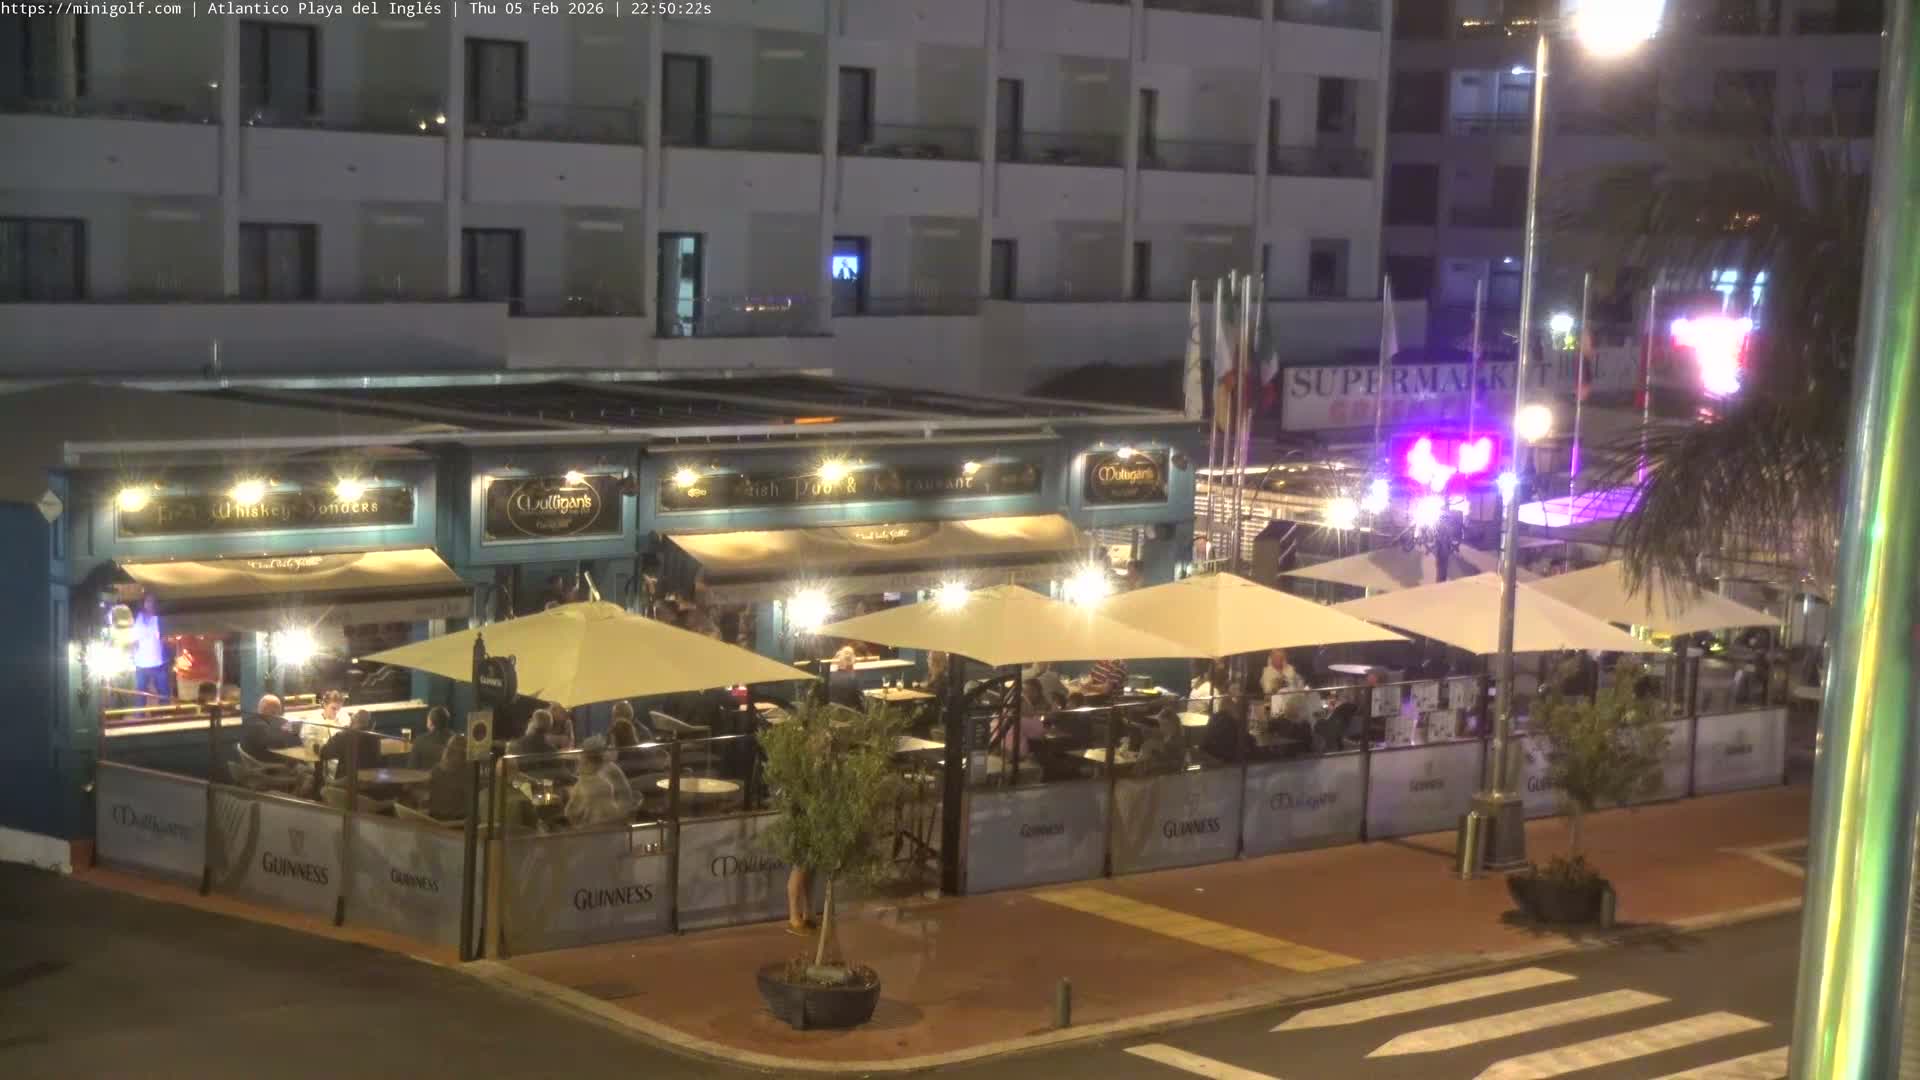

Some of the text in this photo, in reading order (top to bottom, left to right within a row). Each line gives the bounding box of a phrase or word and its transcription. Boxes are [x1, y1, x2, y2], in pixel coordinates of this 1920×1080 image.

[516, 493, 592, 515] Mulligan's
[1163, 817, 1221, 839] GUINNESS
[262, 851, 329, 886] GUINNESS
[574, 884, 653, 911] GUINNESS
